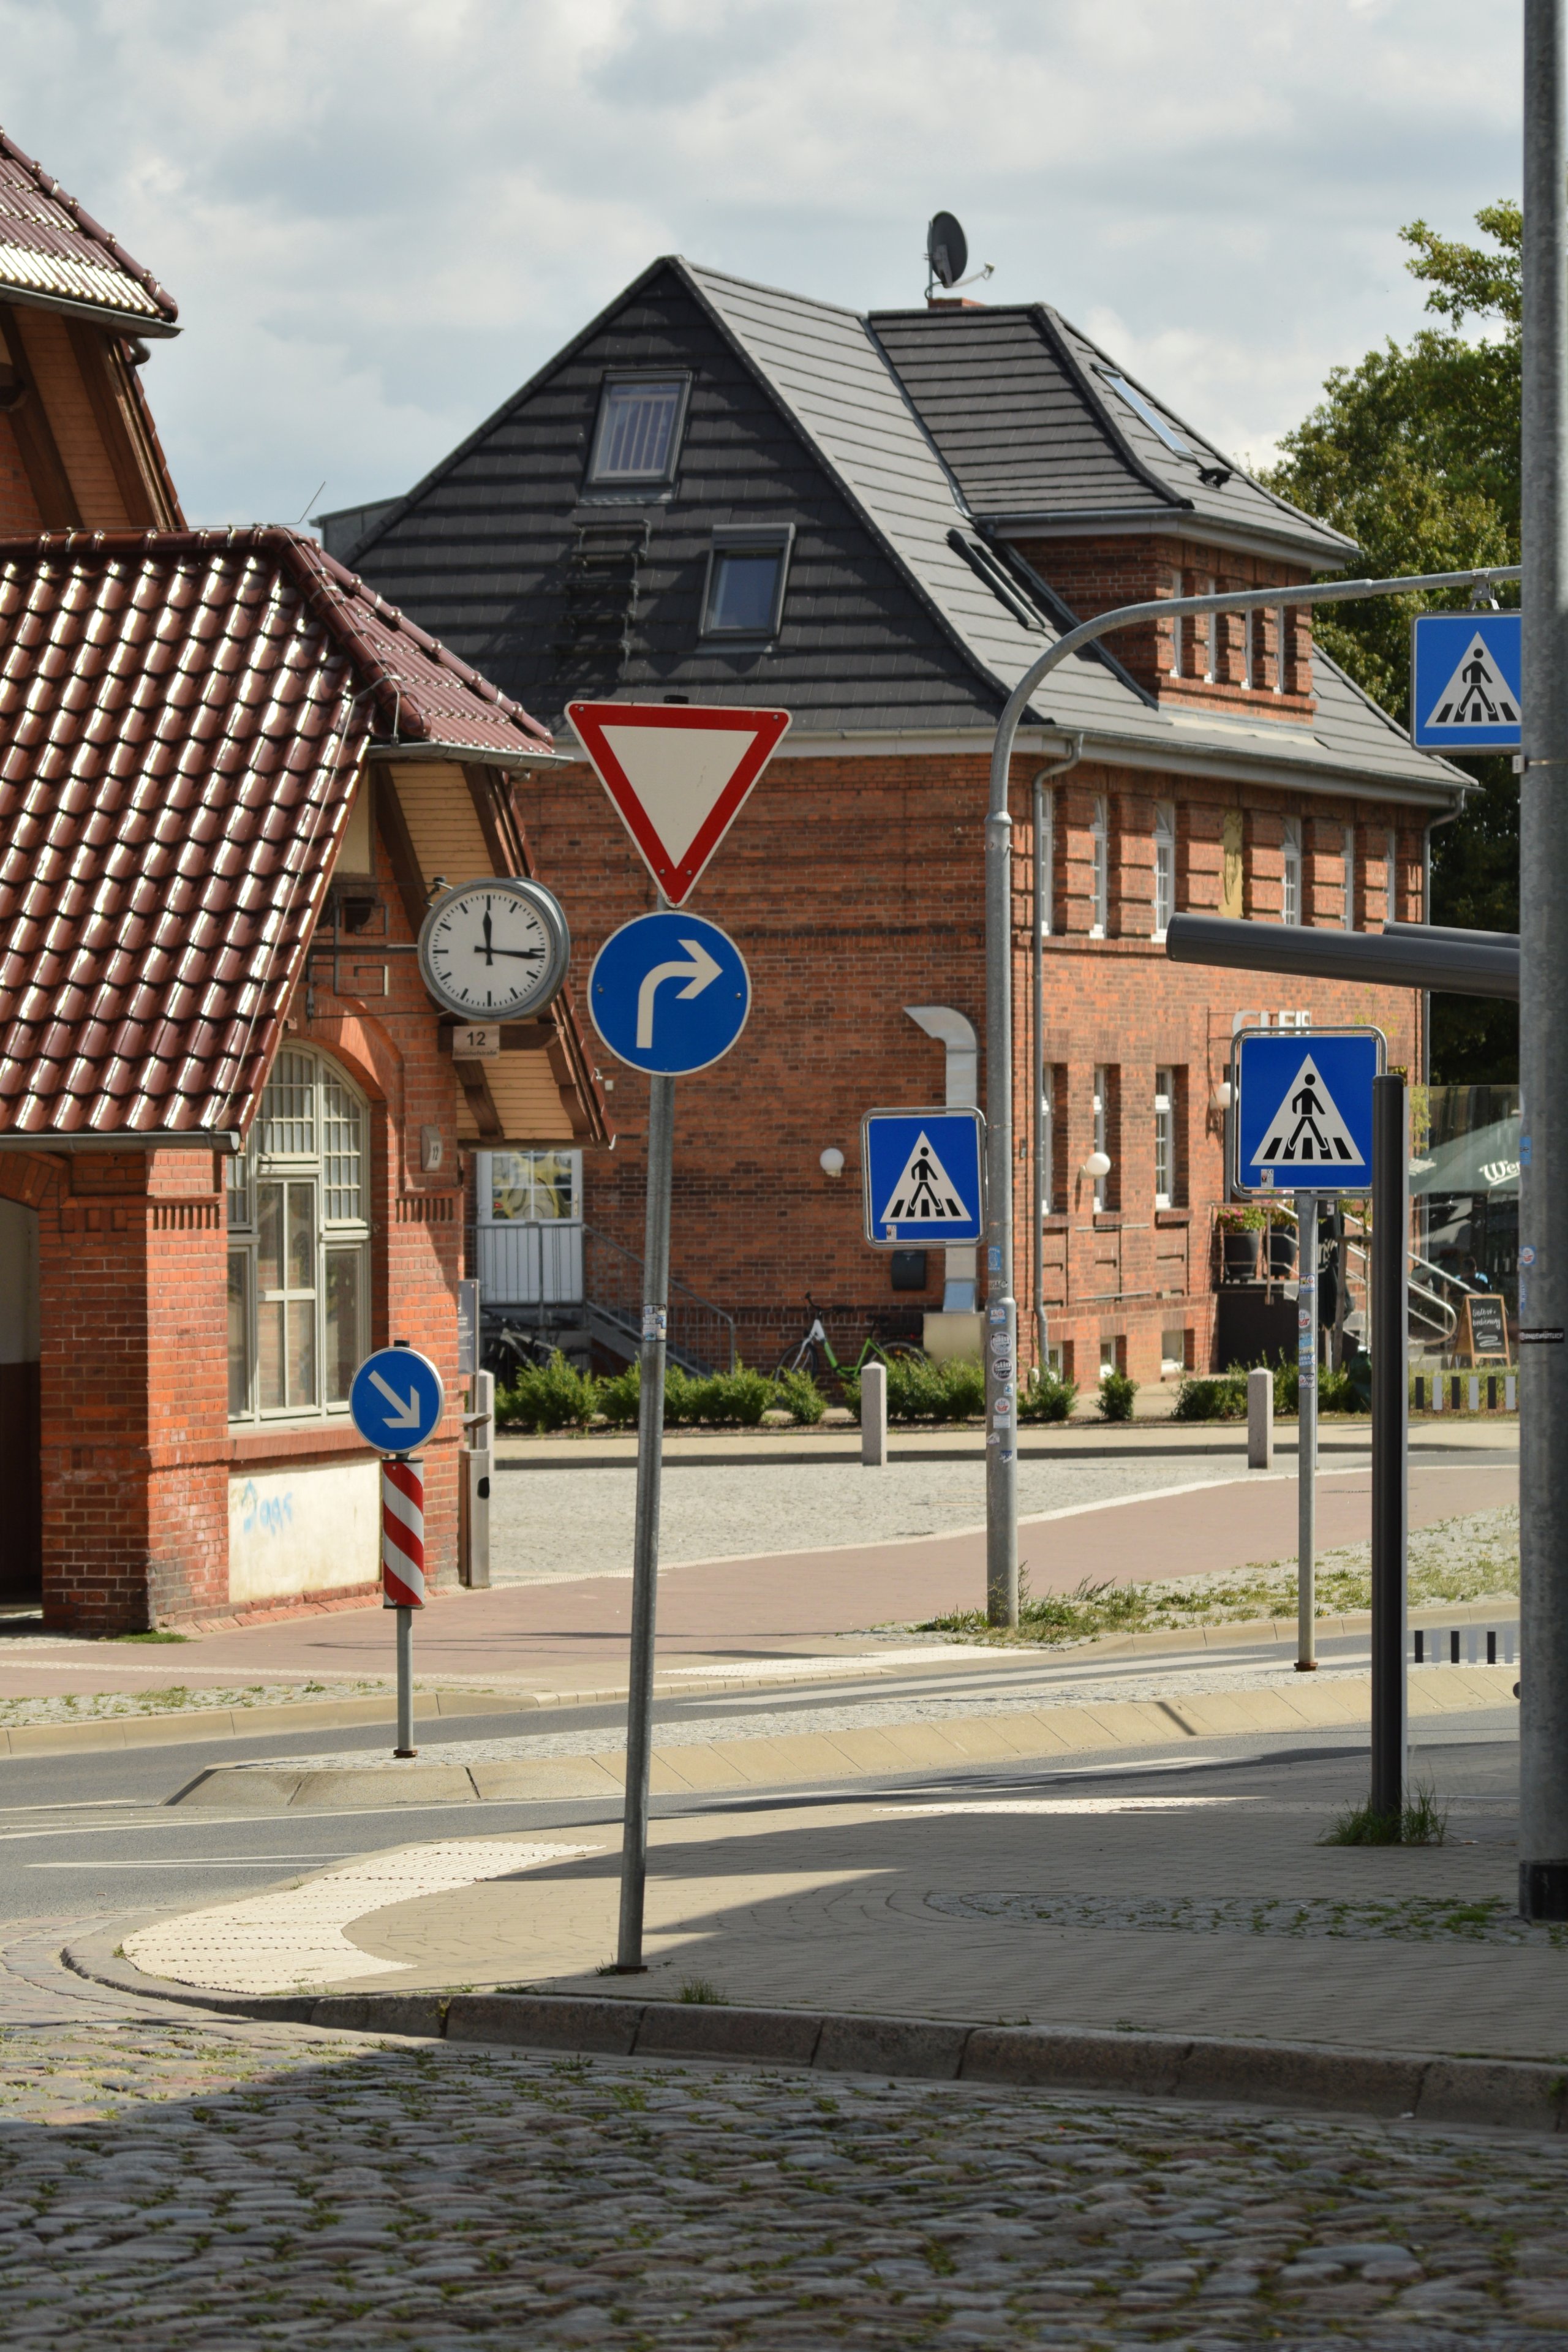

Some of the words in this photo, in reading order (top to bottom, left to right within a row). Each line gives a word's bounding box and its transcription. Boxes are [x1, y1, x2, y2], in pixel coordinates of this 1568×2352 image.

[467, 1031, 486, 1046] 12
[432, 1145, 439, 1161] 12
[1472, 1317, 1501, 1330] bedienung
